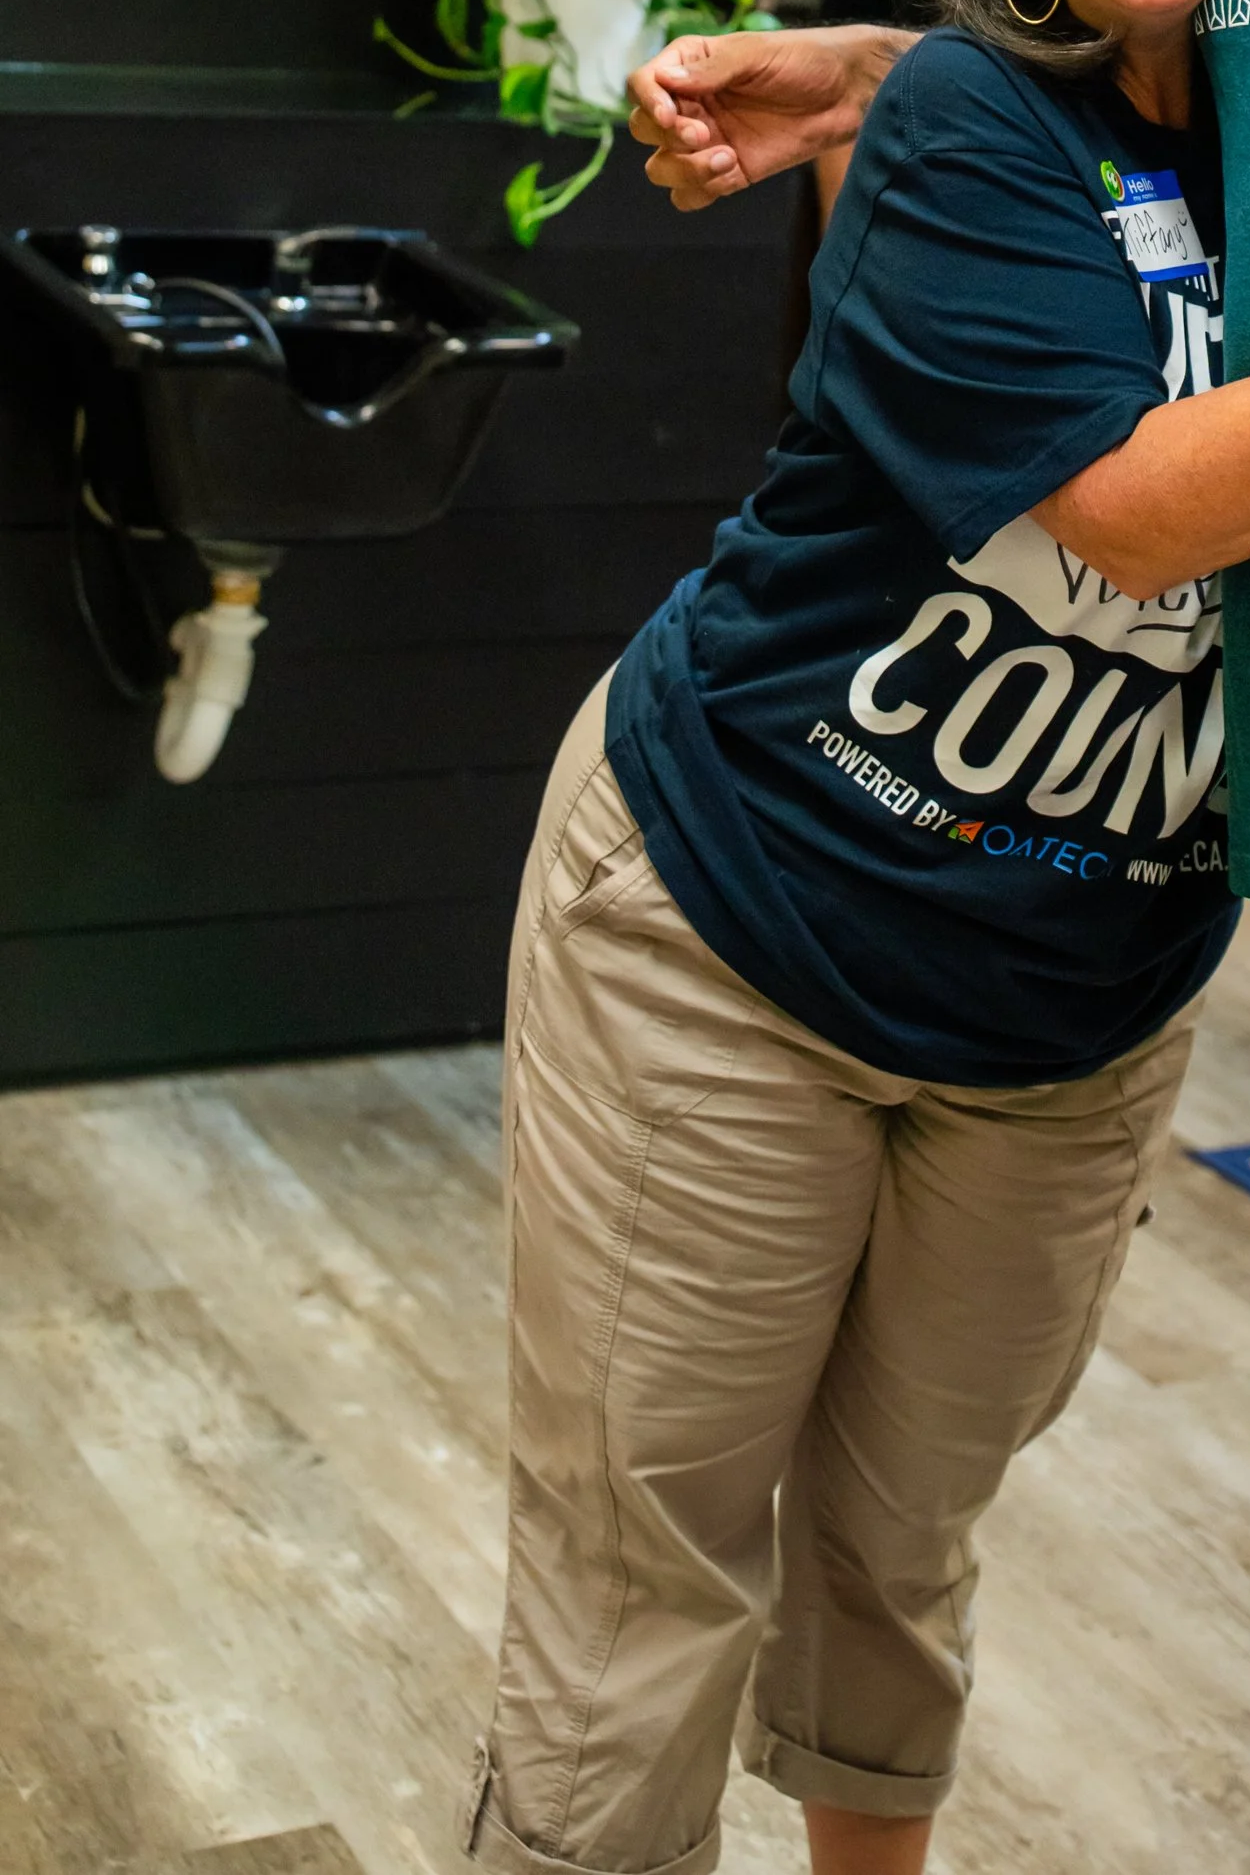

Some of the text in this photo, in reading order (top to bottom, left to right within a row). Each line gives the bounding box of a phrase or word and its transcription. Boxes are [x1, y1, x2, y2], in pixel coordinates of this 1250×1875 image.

[1127, 177, 1154, 195] Hello
[806, 719, 920, 815] POWERED
[912, 799, 957, 831] BY
